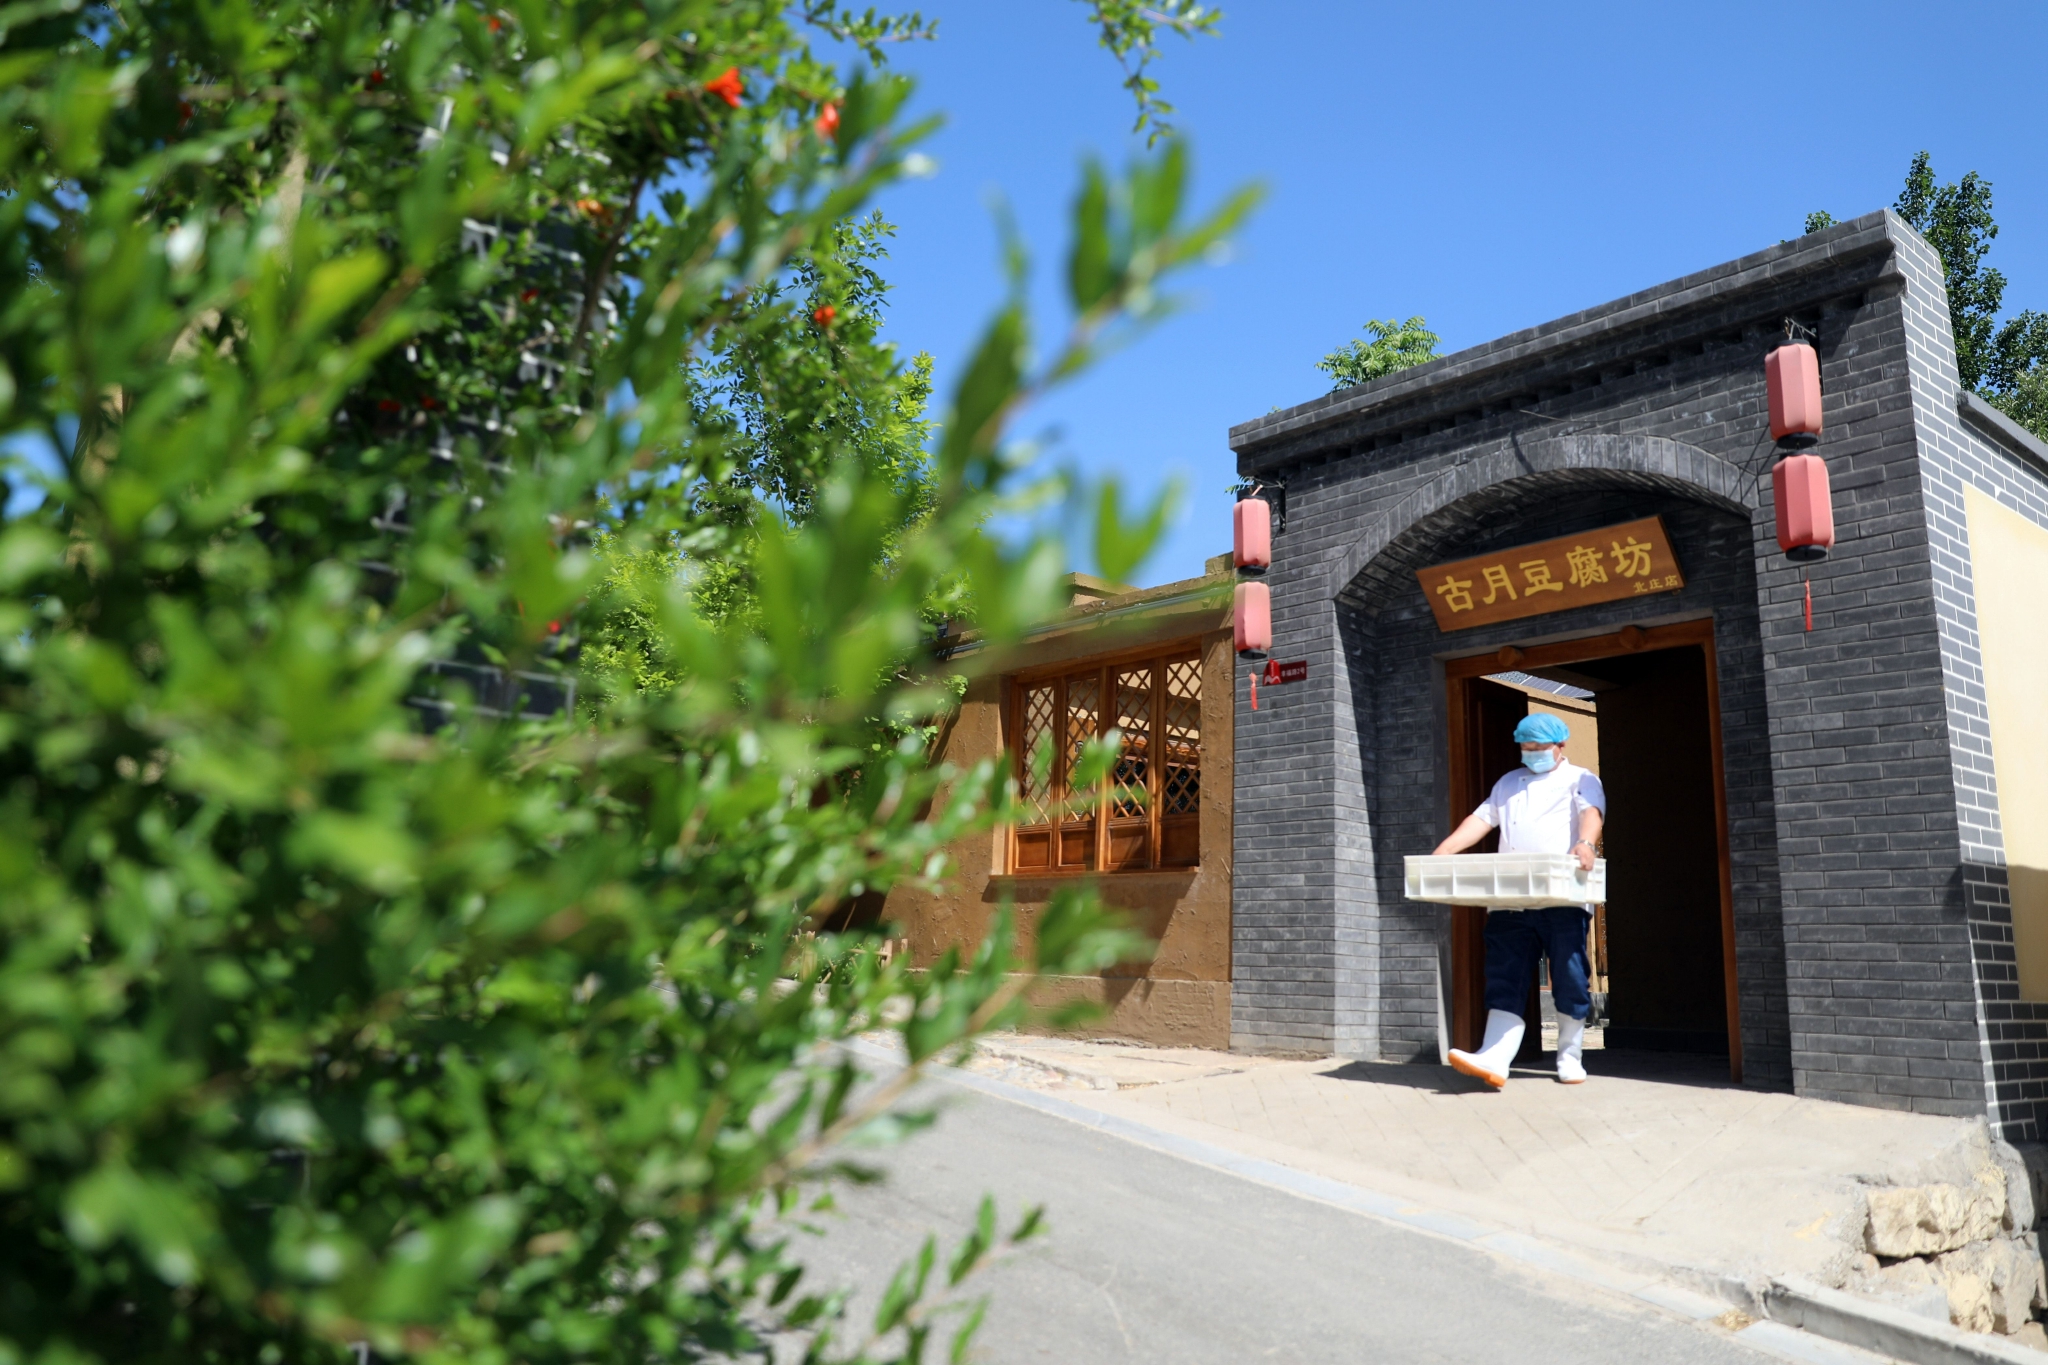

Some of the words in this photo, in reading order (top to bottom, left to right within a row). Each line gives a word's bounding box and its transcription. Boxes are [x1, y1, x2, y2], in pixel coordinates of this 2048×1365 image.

[1437, 536, 1653, 613] 古月豆腐坊
[1633, 575, 1679, 593] 北庄店
